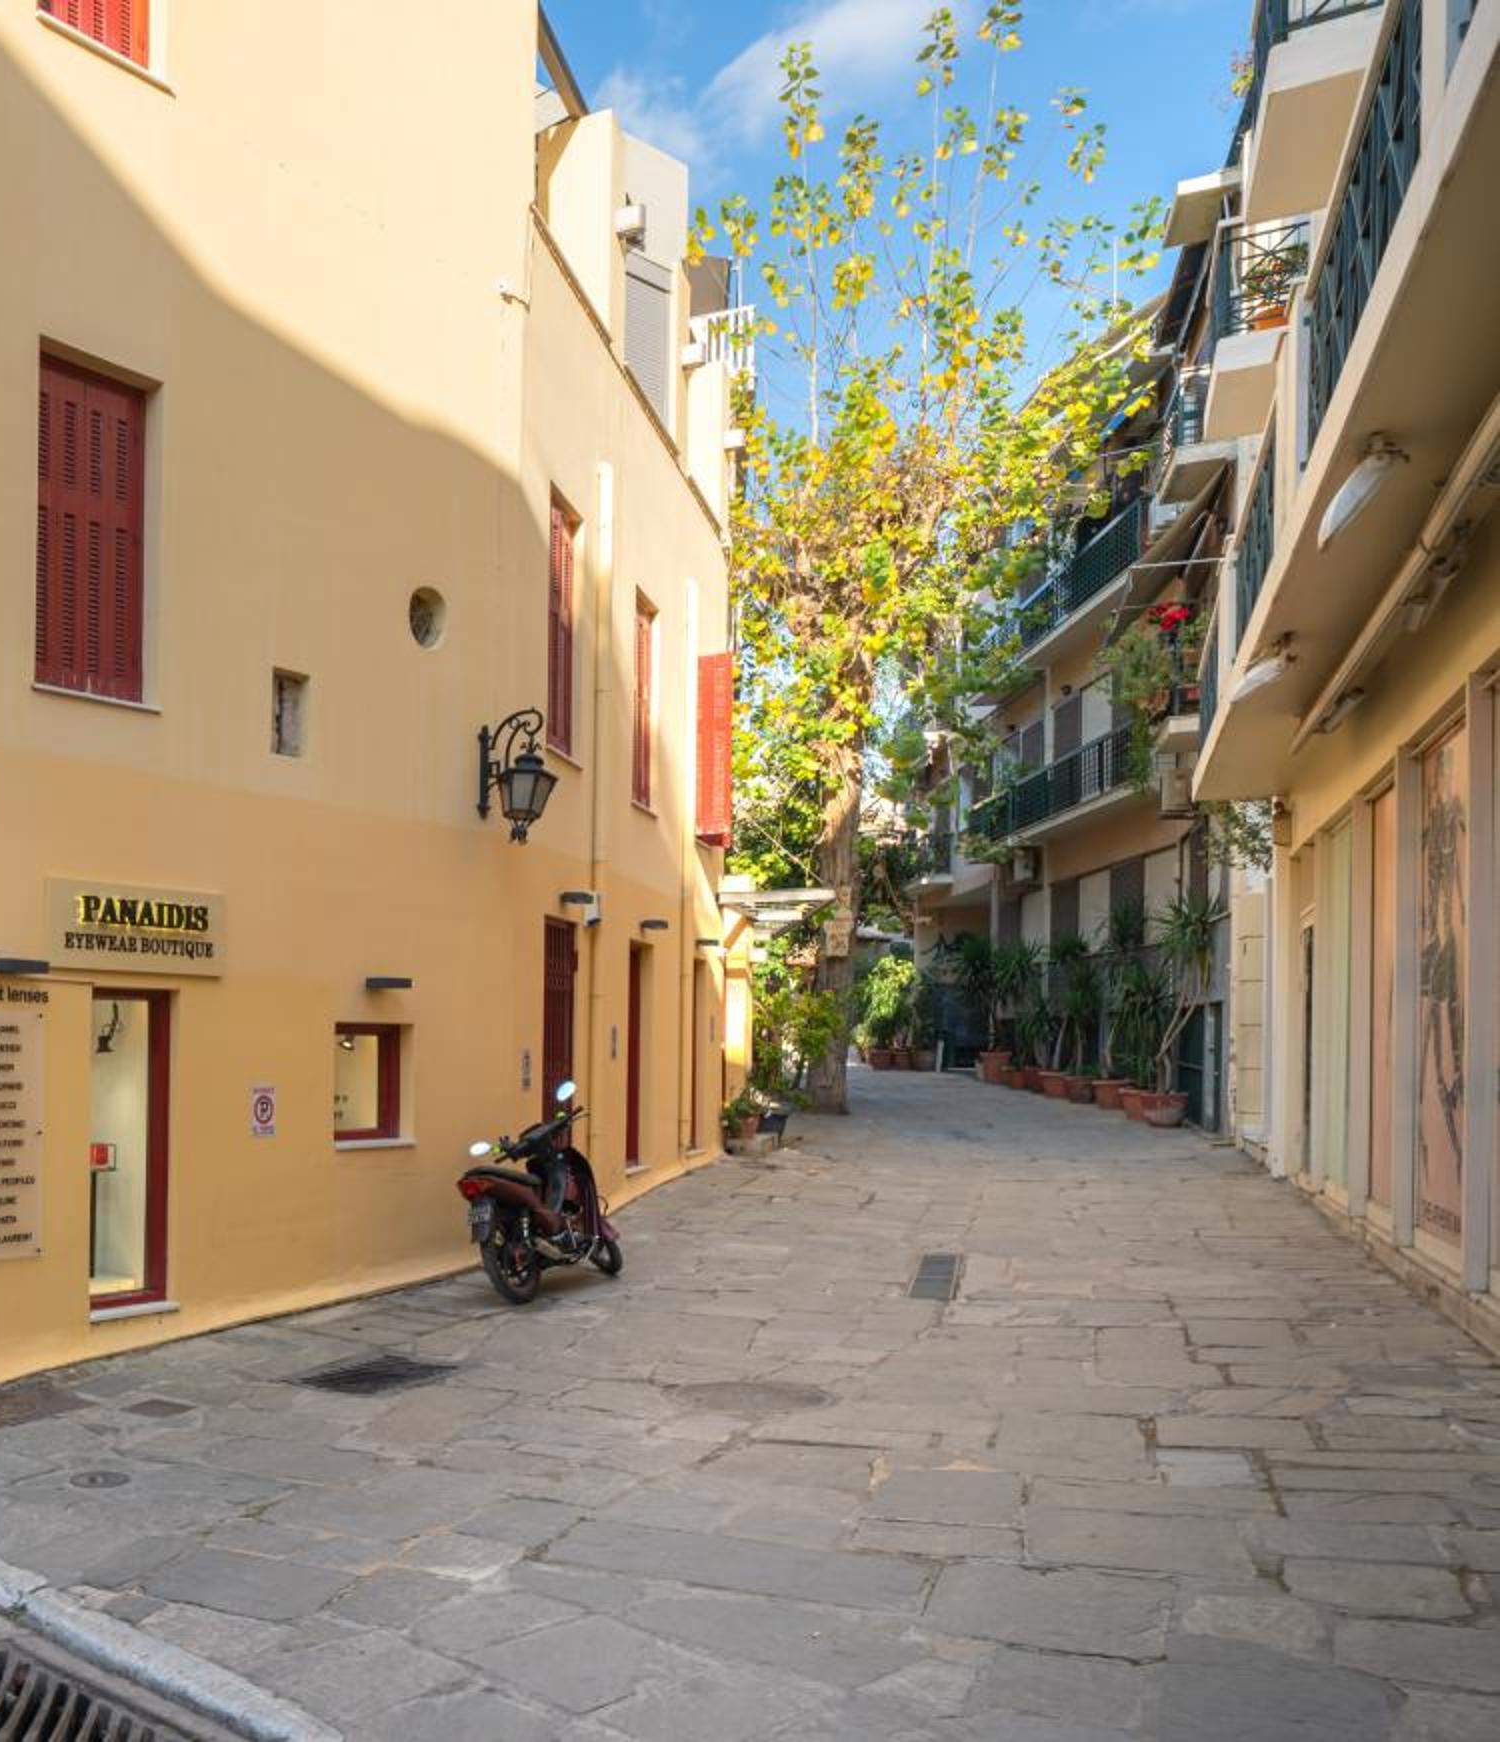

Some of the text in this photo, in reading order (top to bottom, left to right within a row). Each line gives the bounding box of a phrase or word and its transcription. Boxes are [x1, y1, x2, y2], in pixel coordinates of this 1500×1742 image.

[80, 895, 209, 932] PANAIDIS
[64, 932, 214, 959] EYEWEAR BOUTIQUE
[8, 986, 49, 1003] lenses
